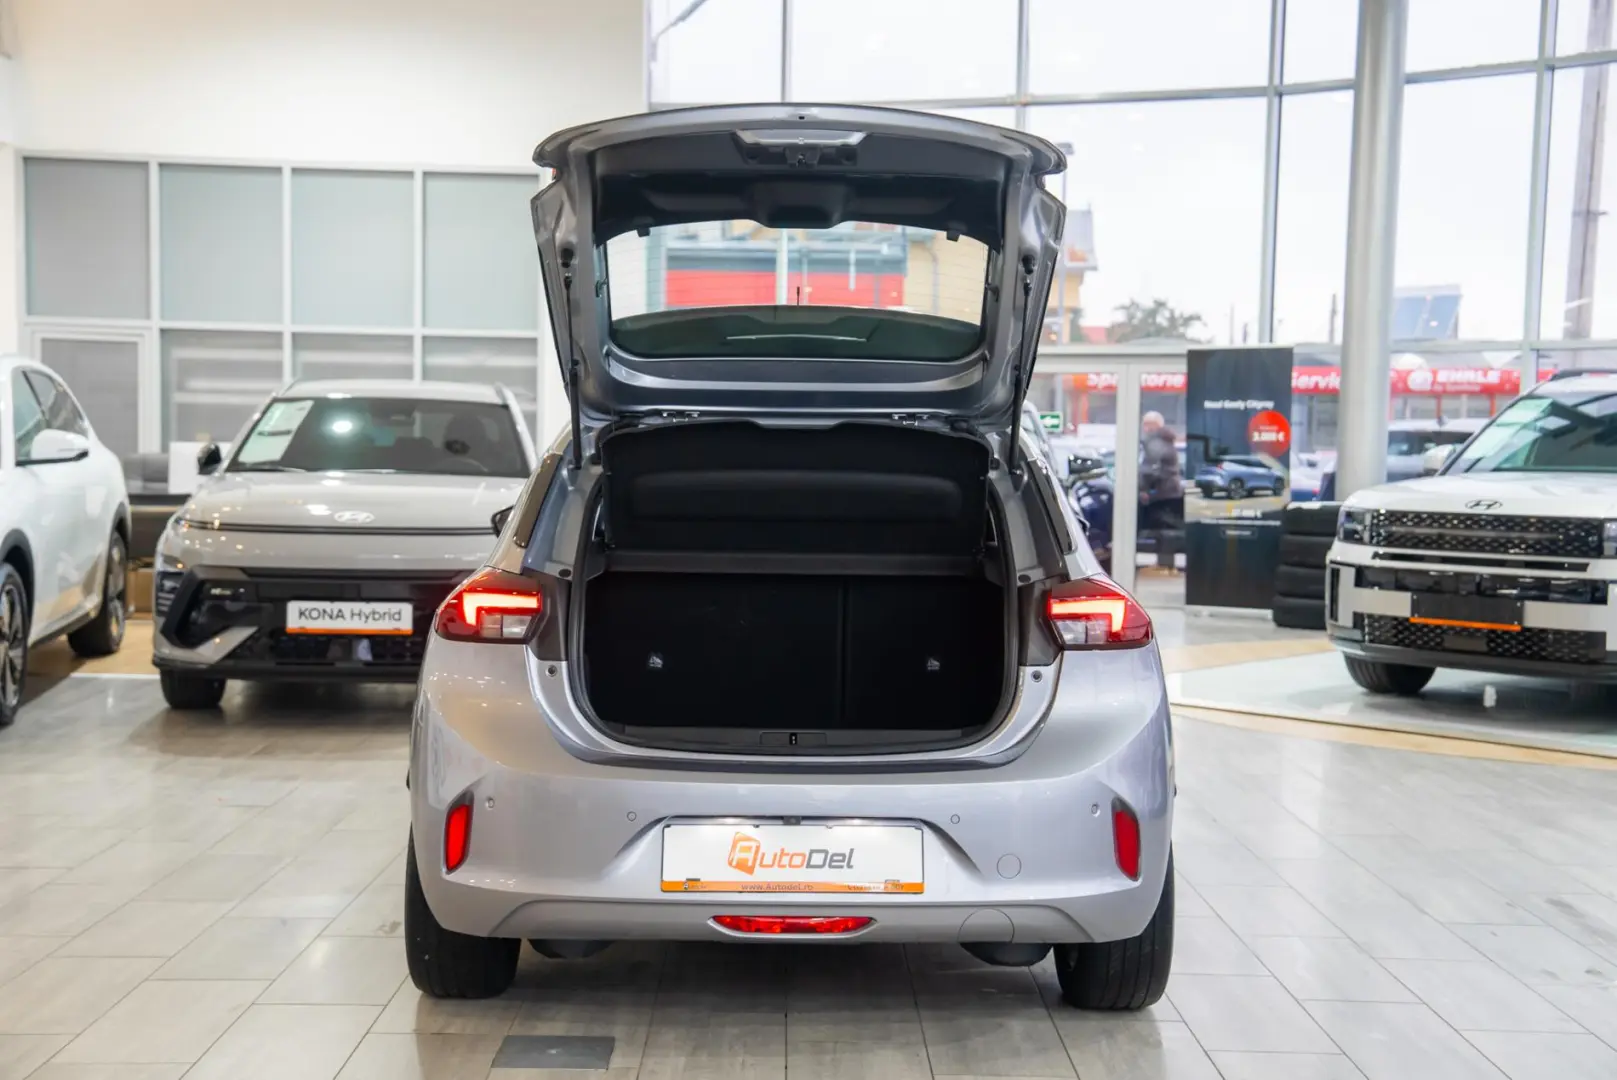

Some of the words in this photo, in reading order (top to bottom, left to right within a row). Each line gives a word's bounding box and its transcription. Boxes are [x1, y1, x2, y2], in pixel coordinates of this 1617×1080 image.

[299, 607, 346, 621] KONA
[350, 608, 402, 624] Hybrid
[729, 836, 854, 871] AutoDel
